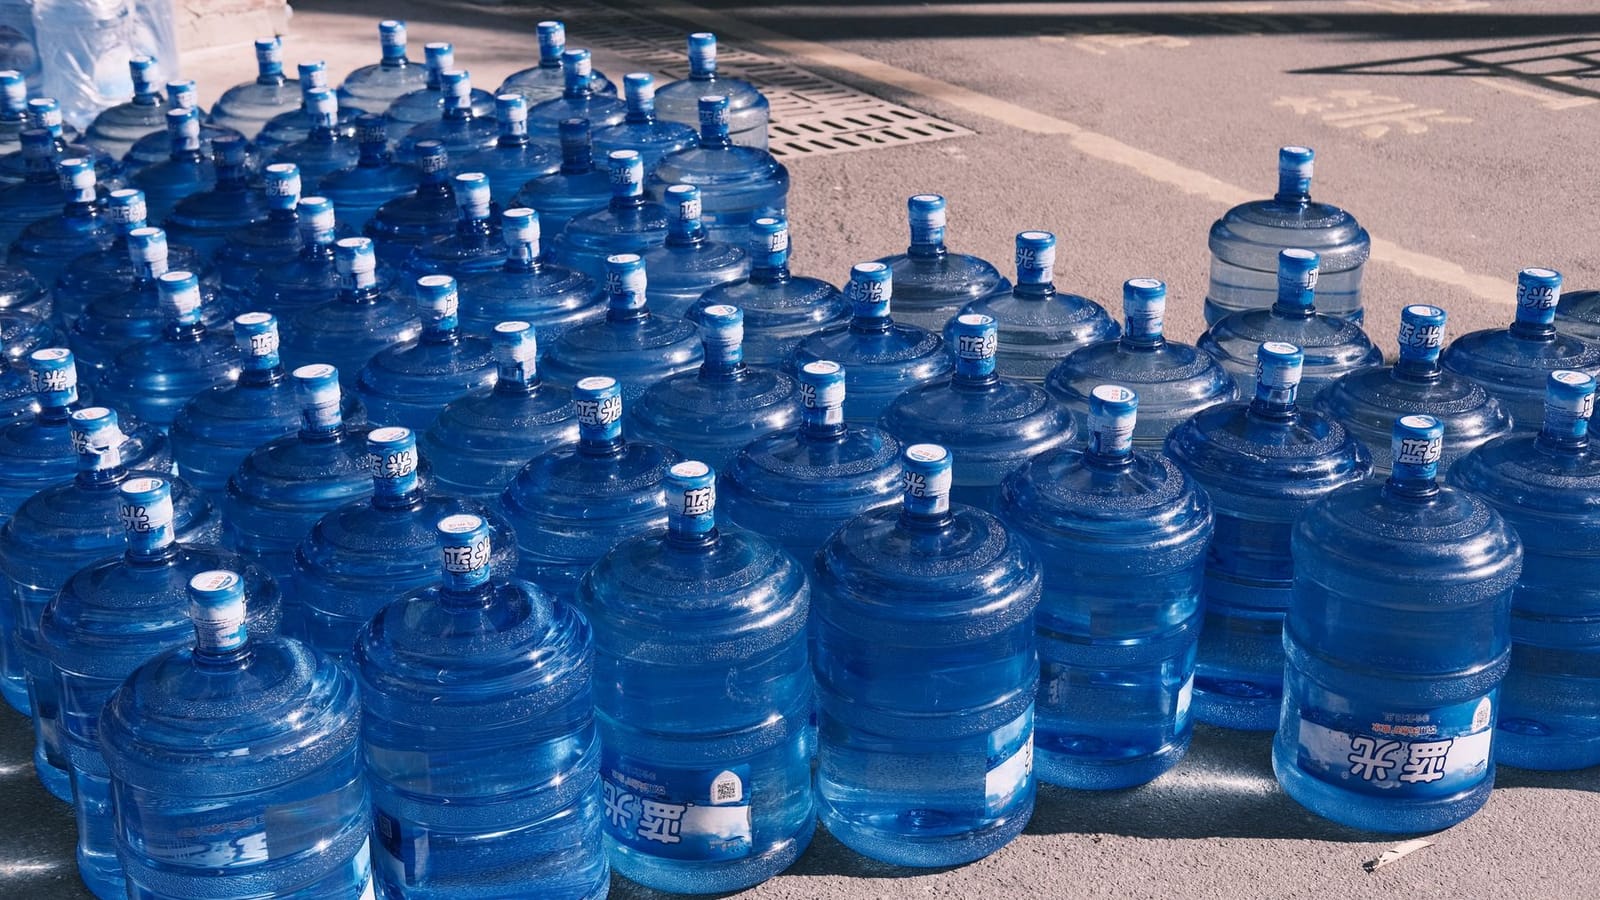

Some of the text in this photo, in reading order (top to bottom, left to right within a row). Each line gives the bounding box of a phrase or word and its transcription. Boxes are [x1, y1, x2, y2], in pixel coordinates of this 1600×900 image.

[576, 396, 622, 424] 蓝光
[902, 471, 926, 497] 光
[683, 487, 716, 515] 蓝
[122, 504, 149, 532] 光
[1348, 735, 1453, 784] 蓝光
[602, 779, 688, 844] 蓝光
